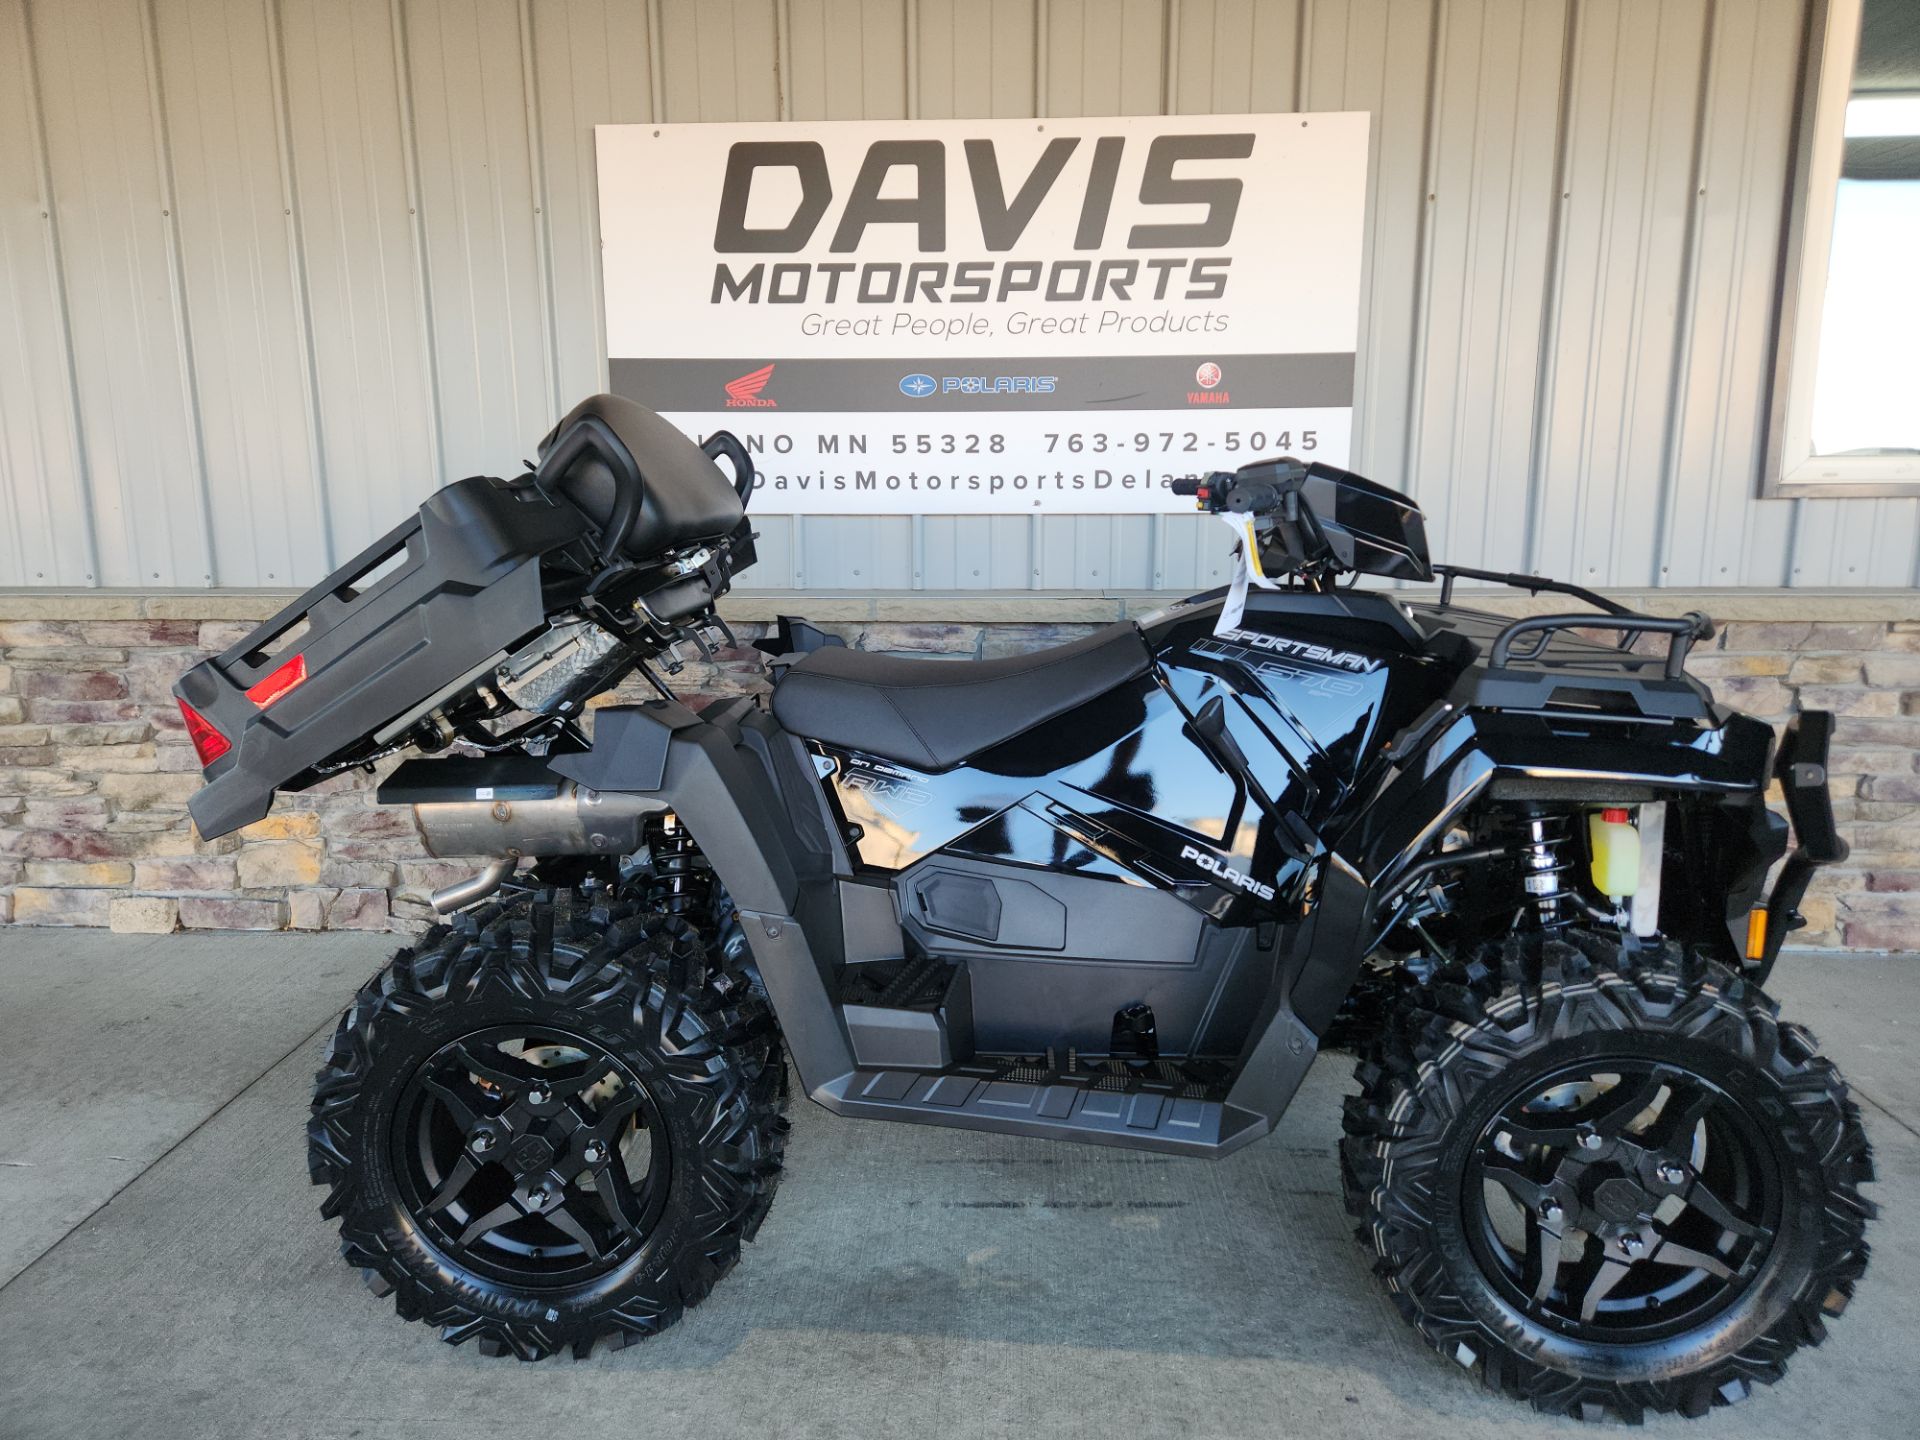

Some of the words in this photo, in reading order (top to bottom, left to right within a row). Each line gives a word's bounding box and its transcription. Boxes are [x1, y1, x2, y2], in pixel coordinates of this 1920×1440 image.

[713, 133, 1256, 253] DAVIS
[710, 257, 1233, 304] MOTORSPORTS
[801, 313, 883, 336] Great
[892, 312, 994, 341] People,
[1006, 311, 1090, 335] Great
[1098, 309, 1230, 334] Products
[942, 376, 1056, 393] POLARIS
[1186, 391, 1230, 404] YAMAHA
[725, 399, 778, 408] HONDA
[817, 434, 868, 454] MN
[891, 433, 1006, 454] 55328
[1044, 430, 1318, 454] 763-972-5045
[1216, 629, 1384, 674] SPORTSMAN
[1180, 844, 1276, 901] POLARIS
